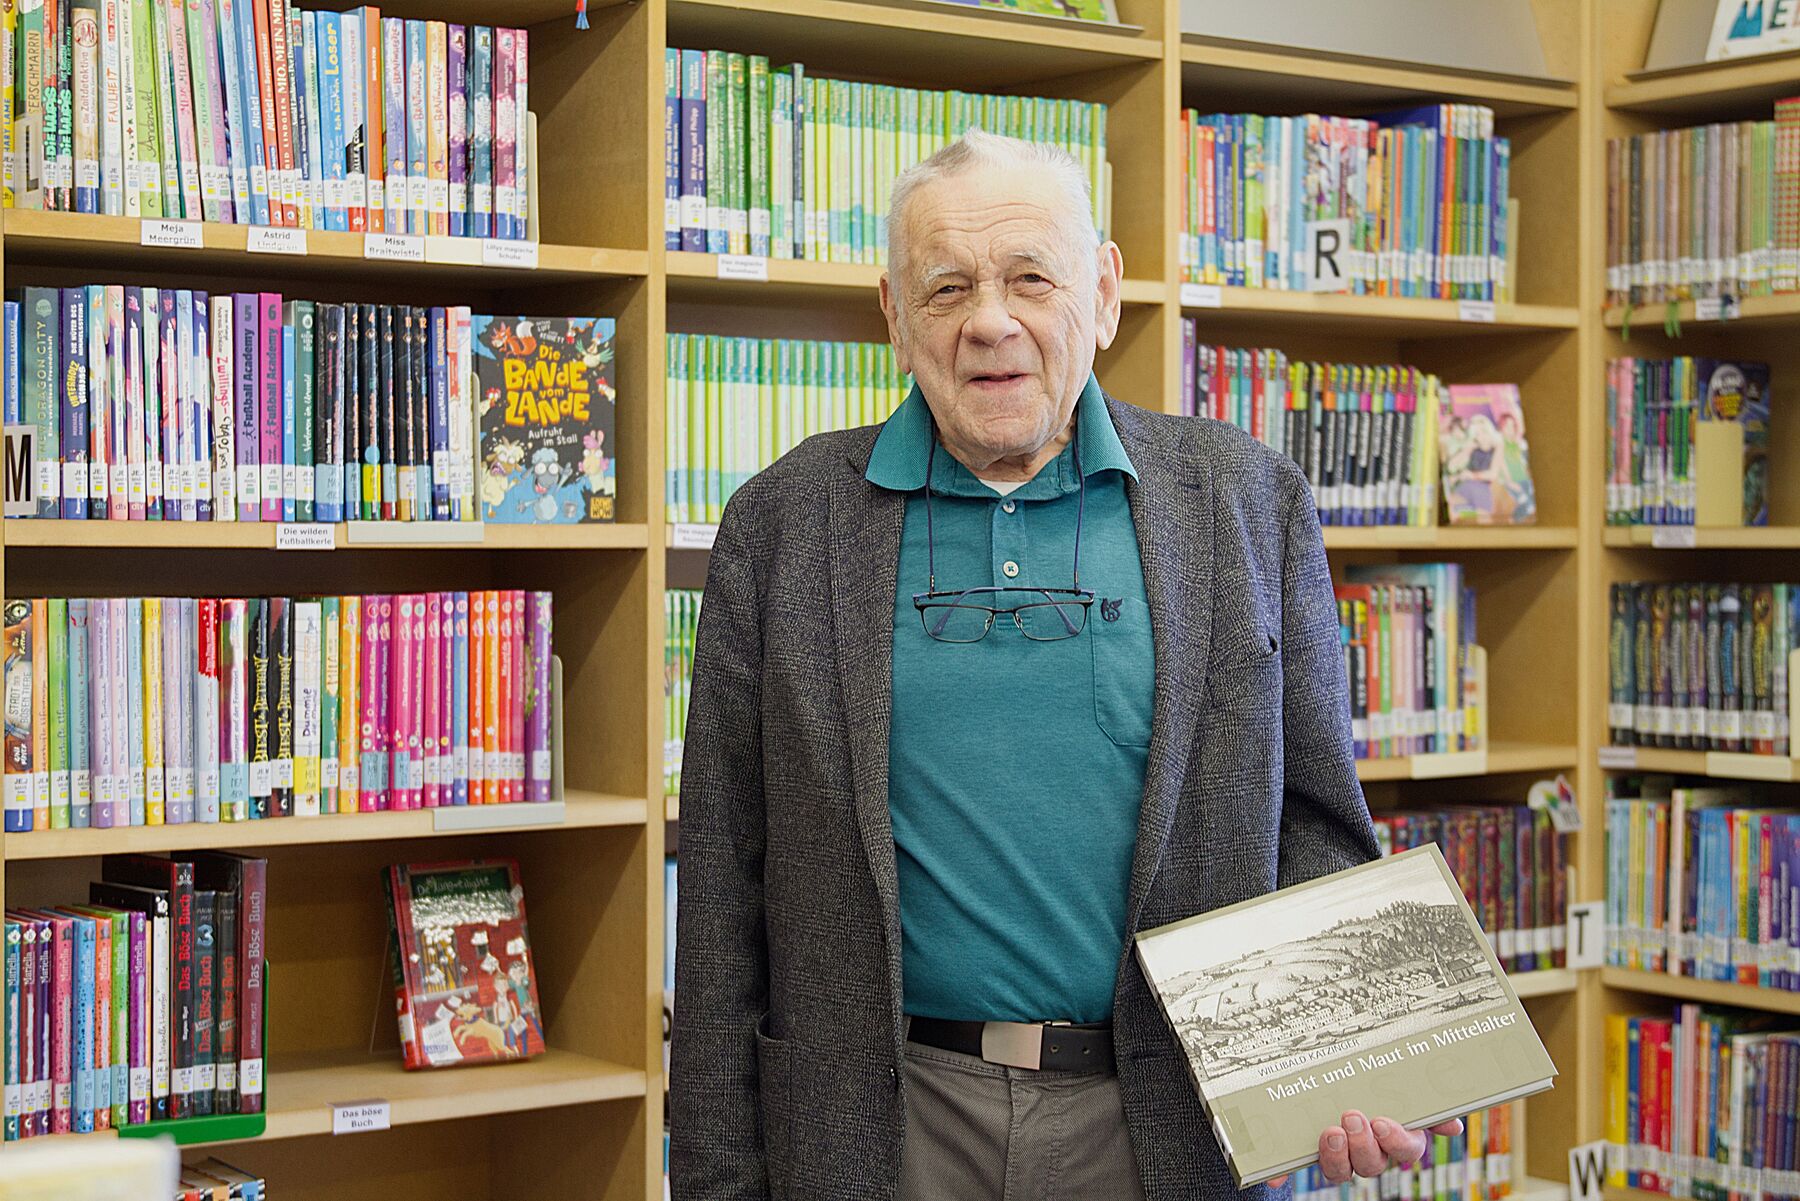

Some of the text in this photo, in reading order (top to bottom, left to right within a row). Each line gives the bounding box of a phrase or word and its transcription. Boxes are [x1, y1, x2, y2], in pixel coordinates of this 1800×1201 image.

[274, 27, 285, 62] MEIN
[323, 23, 340, 76] Loser
[80, 52, 90, 111] Zeitdetektive
[106, 67, 118, 123] FAULHEIT
[138, 89, 157, 157] Anderwald
[249, 96, 261, 128] Michel
[265, 98, 275, 131] Michel
[281, 98, 290, 148] LINDGREN
[149, 234, 196, 245] Meergrün
[161, 223, 184, 233] Meja
[264, 231, 290, 240] Astrid
[385, 237, 406, 246] Miss
[369, 247, 421, 257] Braitwistle
[1315, 229, 1341, 279] R
[36, 321, 47, 355] CITY
[539, 344, 561, 360] Die
[242, 304, 255, 427] Fußball Academy 5
[266, 304, 278, 426] Fußball Academy 6
[37, 359, 47, 418] DRAGON
[66, 360, 80, 407] UNTERHOLZ
[214, 356, 230, 414] Zwillings-
[303, 373, 312, 404] Urwald
[539, 388, 565, 399] vom
[528, 427, 563, 439] Aufruhr
[543, 434, 578, 446] im Stall
[5, 434, 31, 501] M
[131, 502, 144, 512] dtv
[184, 502, 195, 513] dtv
[200, 502, 211, 513] dtv
[280, 537, 331, 545] Fußballkerle
[21, 671, 31, 693] TIERE
[253, 654, 269, 712] BETHANY
[277, 652, 292, 710] BETHANY
[9, 688, 19, 715] STADT
[302, 688, 312, 737] Dummie
[253, 719, 269, 763] BIEST
[277, 717, 292, 760] BIEST
[178, 894, 191, 926] Buch
[248, 891, 261, 923] Buch
[178, 931, 190, 961] Böse
[196, 924, 214, 947] 3
[248, 928, 260, 959] Böse
[1573, 909, 1589, 956] T
[7, 953, 17, 986] Mariella
[23, 951, 33, 985] Mariella
[40, 950, 49, 984] Mariella
[60, 948, 69, 981] Mariella
[116, 942, 124, 976] Mariella
[134, 940, 144, 974] Mariella
[198, 955, 213, 987] Buch
[221, 956, 235, 988] Buch
[178, 967, 190, 991] Das
[248, 963, 260, 989] Das
[198, 989, 211, 1019] Böse
[222, 990, 234, 1019] Böse
[199, 1028, 211, 1053] Das
[1266, 1011, 1517, 1102] Markt und Maut im Mittelalter
[1257, 1038, 1361, 1078] WILLIBALD KATZINGER
[342, 1106, 383, 1119] Das böse
[351, 1118, 374, 1129] Buch
[1574, 1151, 1605, 1197] W
